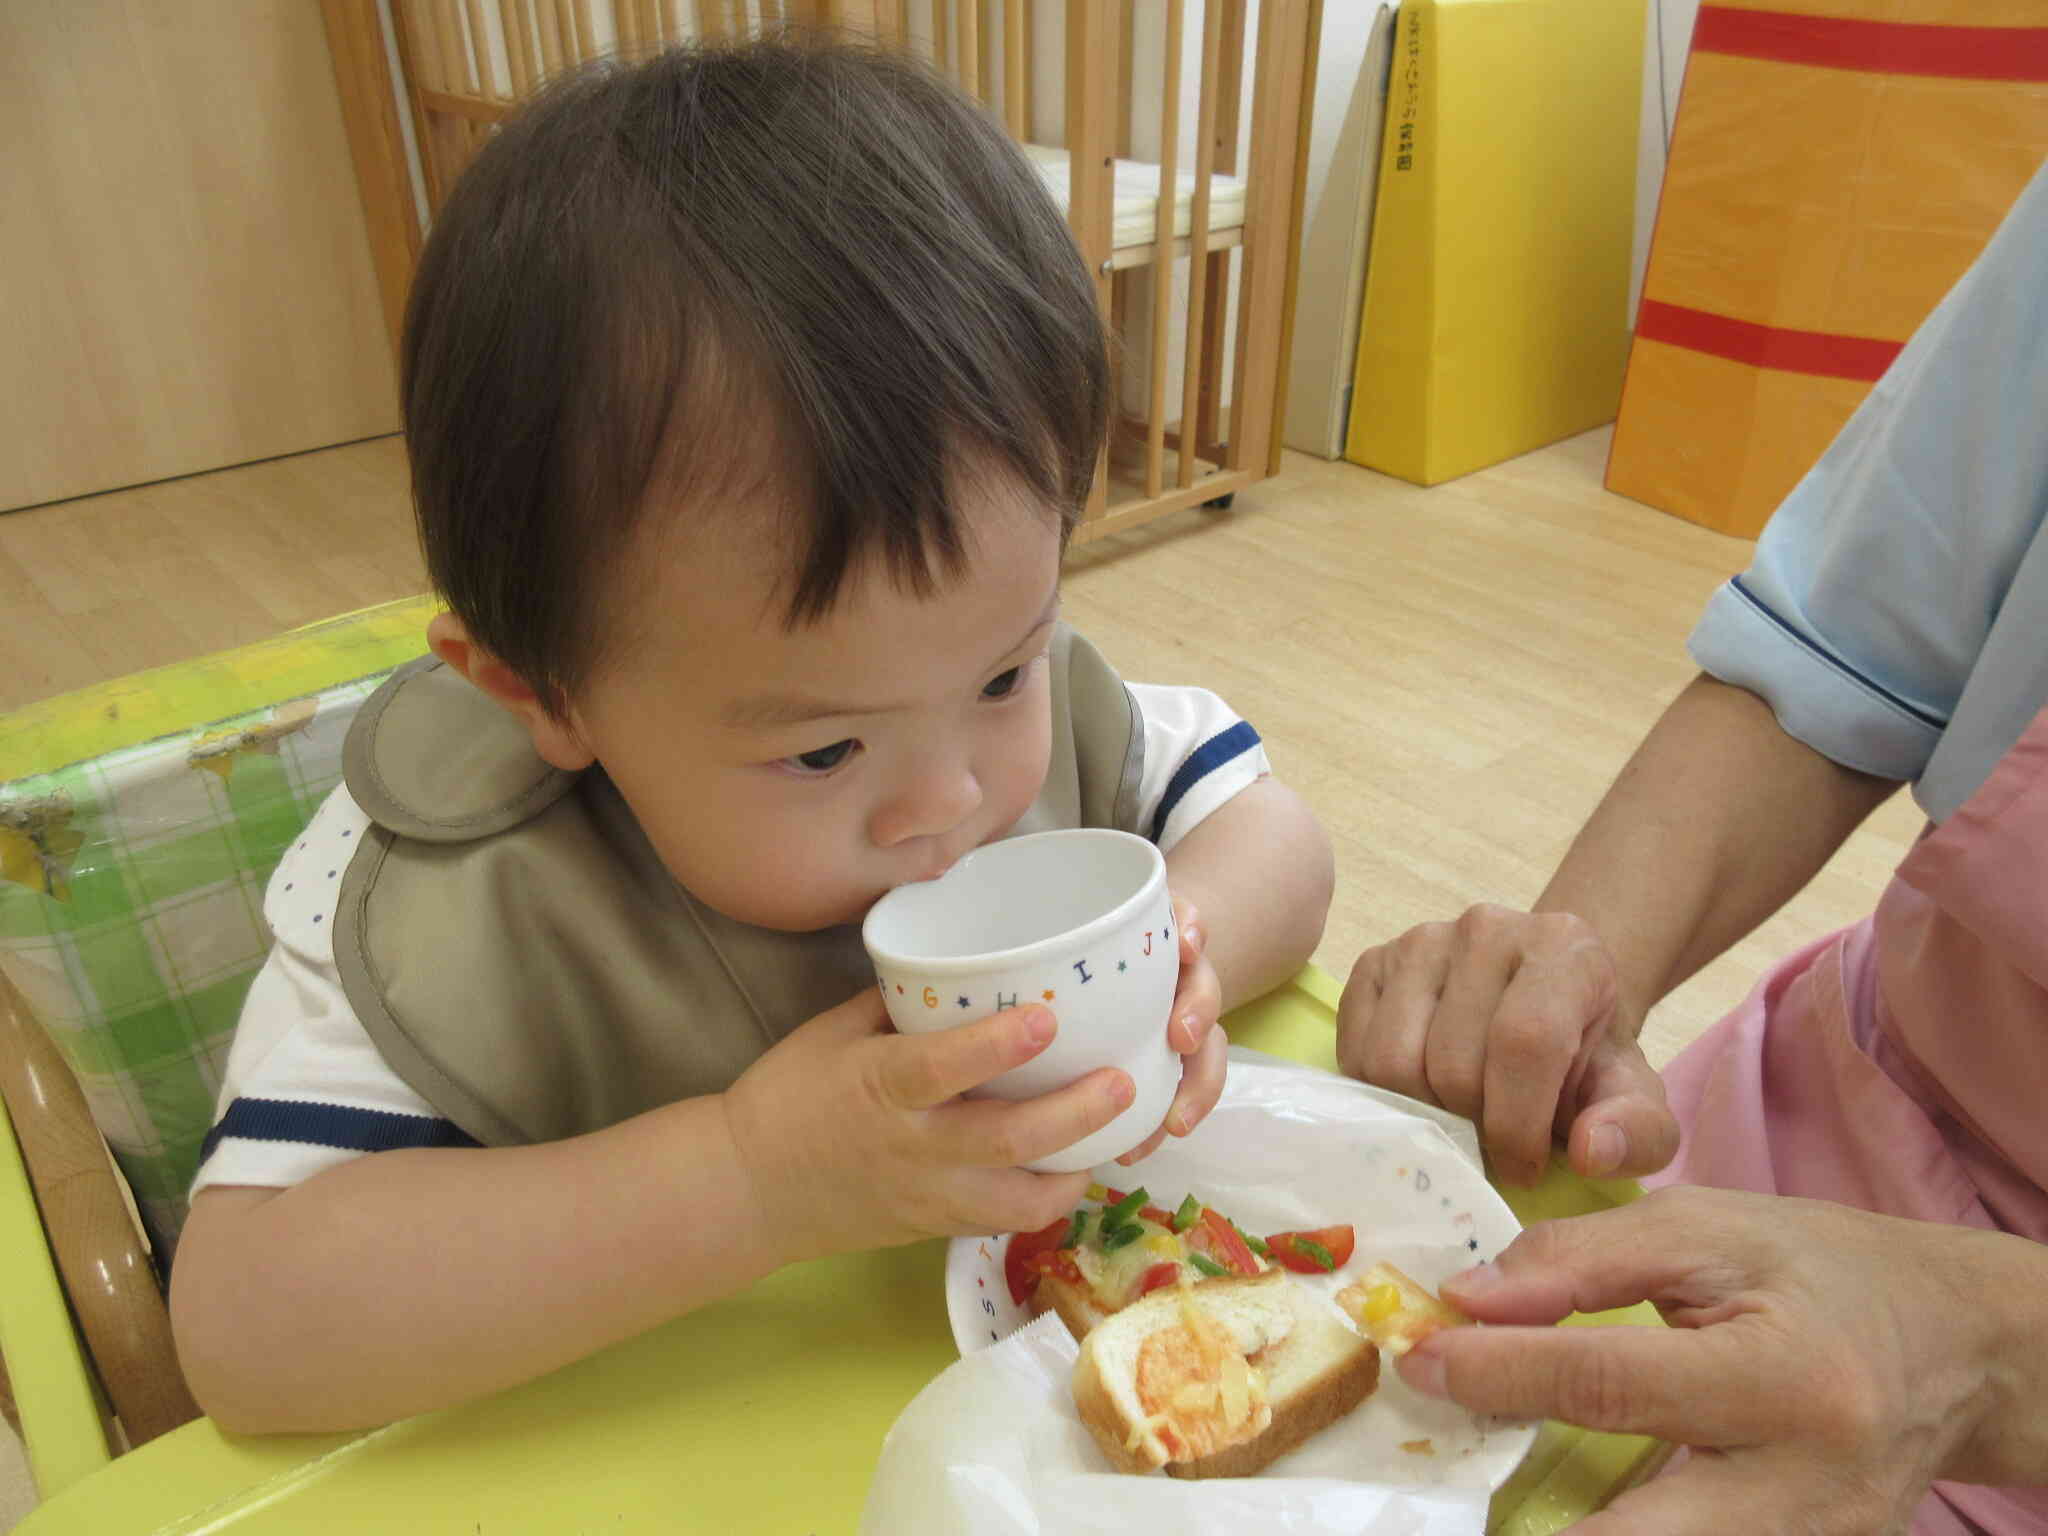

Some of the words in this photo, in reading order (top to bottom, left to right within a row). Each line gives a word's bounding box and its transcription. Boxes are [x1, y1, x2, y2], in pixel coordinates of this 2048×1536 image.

[922, 986, 939, 1009] G
[997, 991, 1017, 1012] H
[1072, 959, 1093, 985] I
[1143, 931, 1153, 956] J
[1415, 1168, 1431, 1192] D
[976, 1241, 992, 1262] T
[982, 1298, 996, 1317] S
